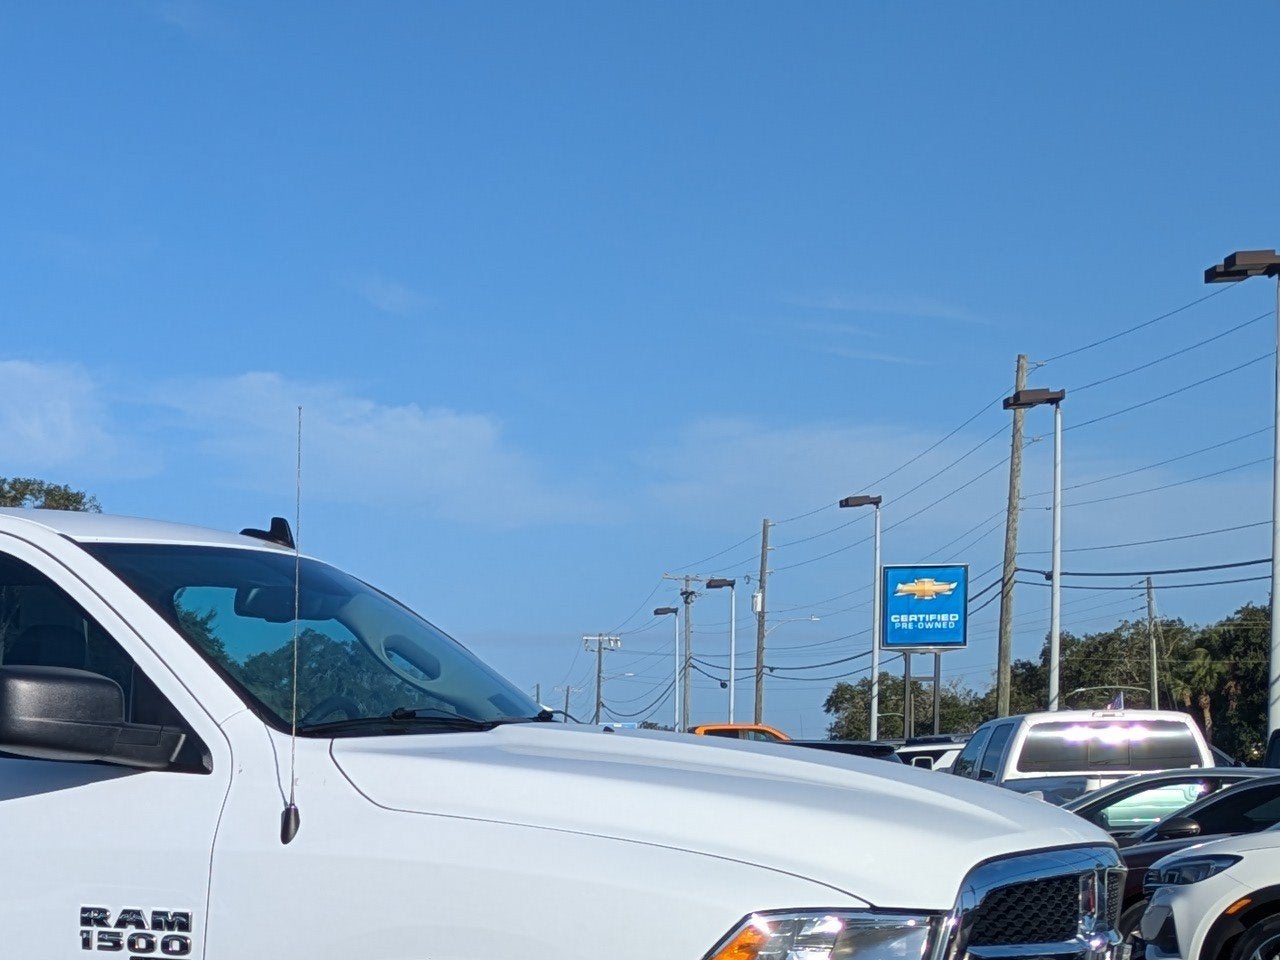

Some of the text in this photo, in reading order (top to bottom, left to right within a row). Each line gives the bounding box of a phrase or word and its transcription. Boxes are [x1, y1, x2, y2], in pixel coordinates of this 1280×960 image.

[890, 613, 959, 623] CERTIFIED
[894, 621, 956, 630] PRE-OWNED
[79, 906, 193, 933] RAM
[79, 929, 192, 956] 1500
